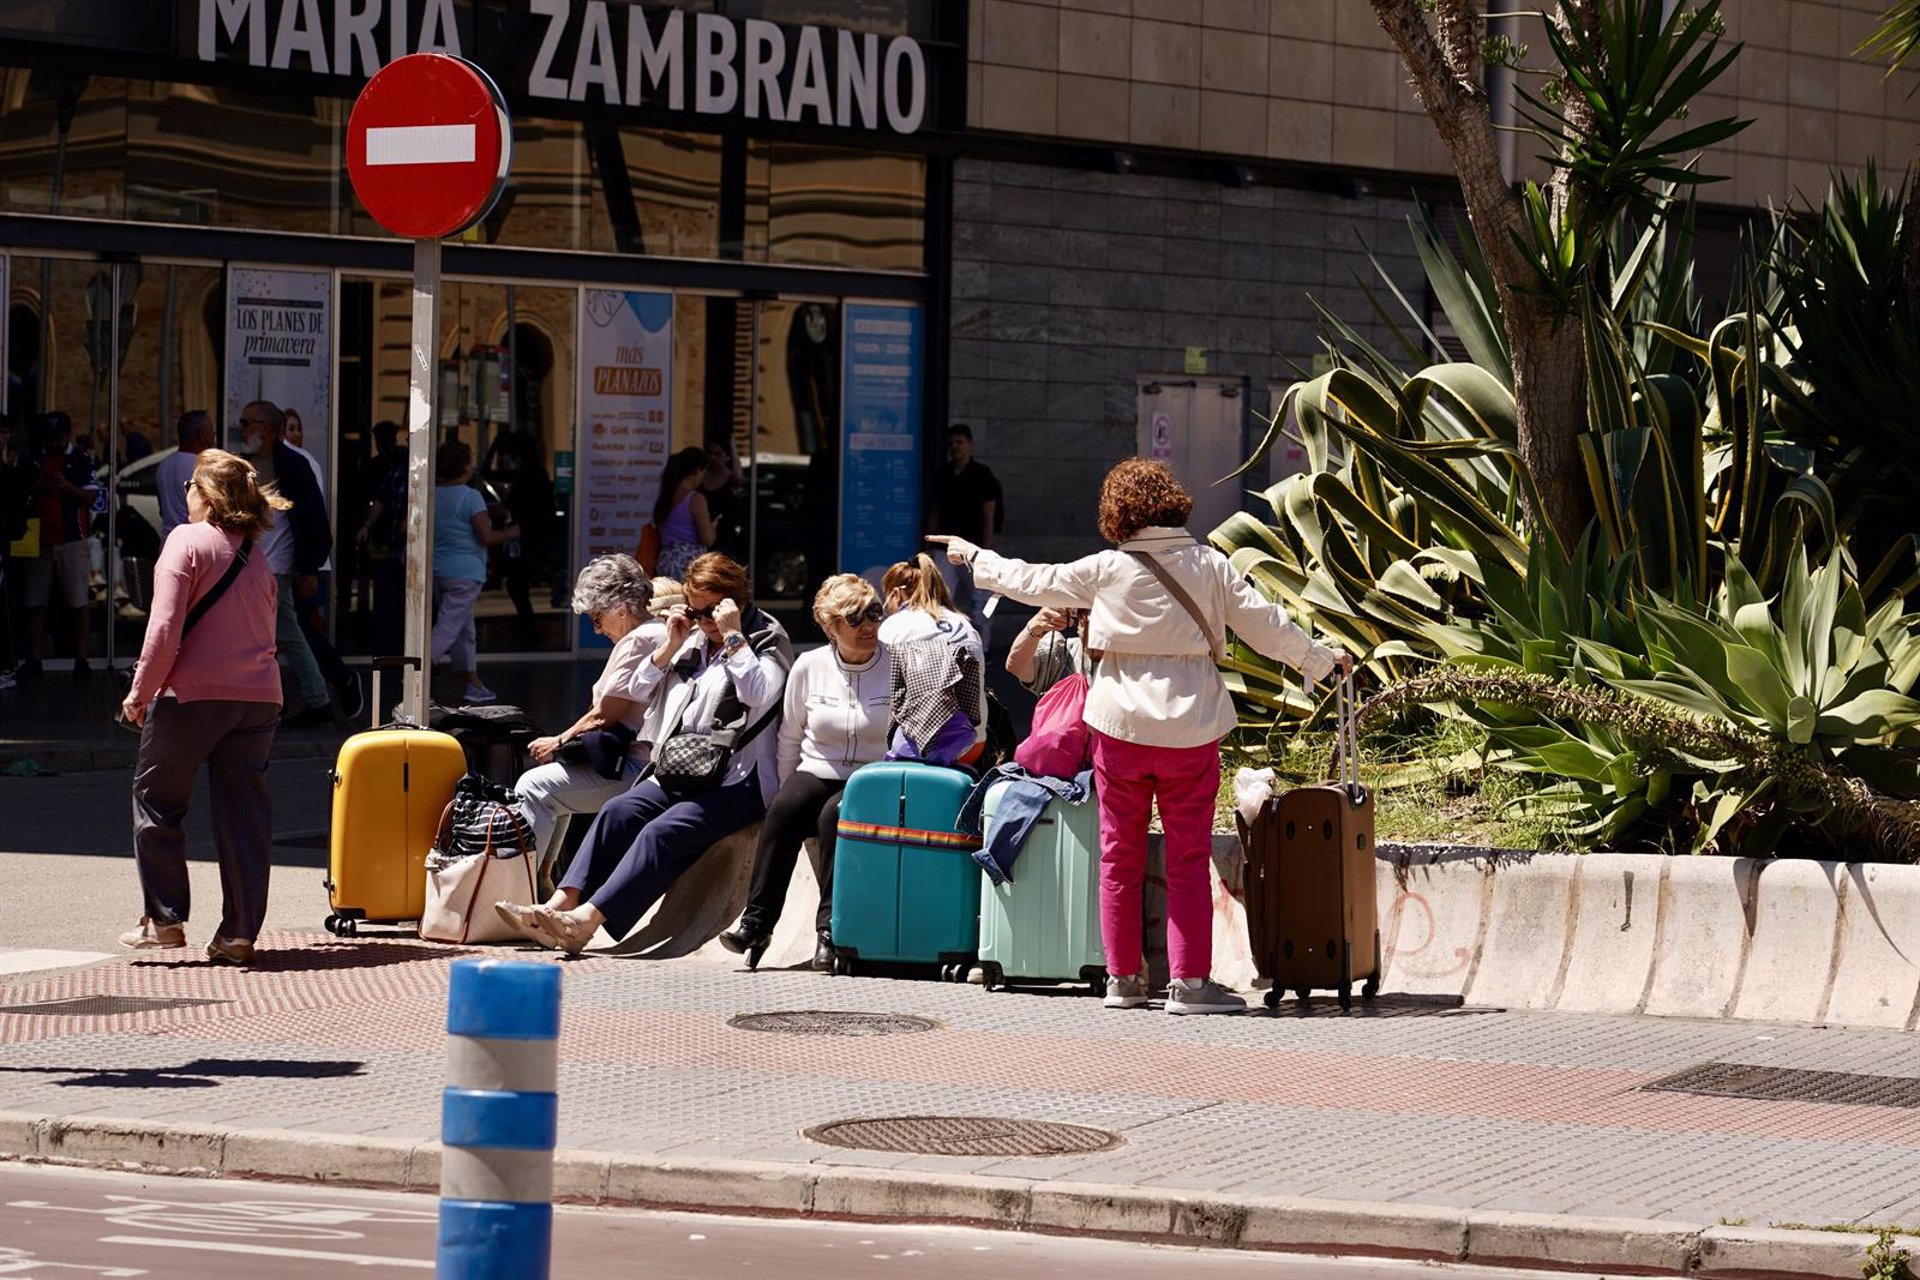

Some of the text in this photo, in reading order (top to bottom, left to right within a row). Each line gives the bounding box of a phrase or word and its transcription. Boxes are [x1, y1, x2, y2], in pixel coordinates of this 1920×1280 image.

[529, 0, 926, 134] ZAMBRANO
[237, 308, 324, 333] LOS PLANES DE
[243, 331, 315, 357] primavera
